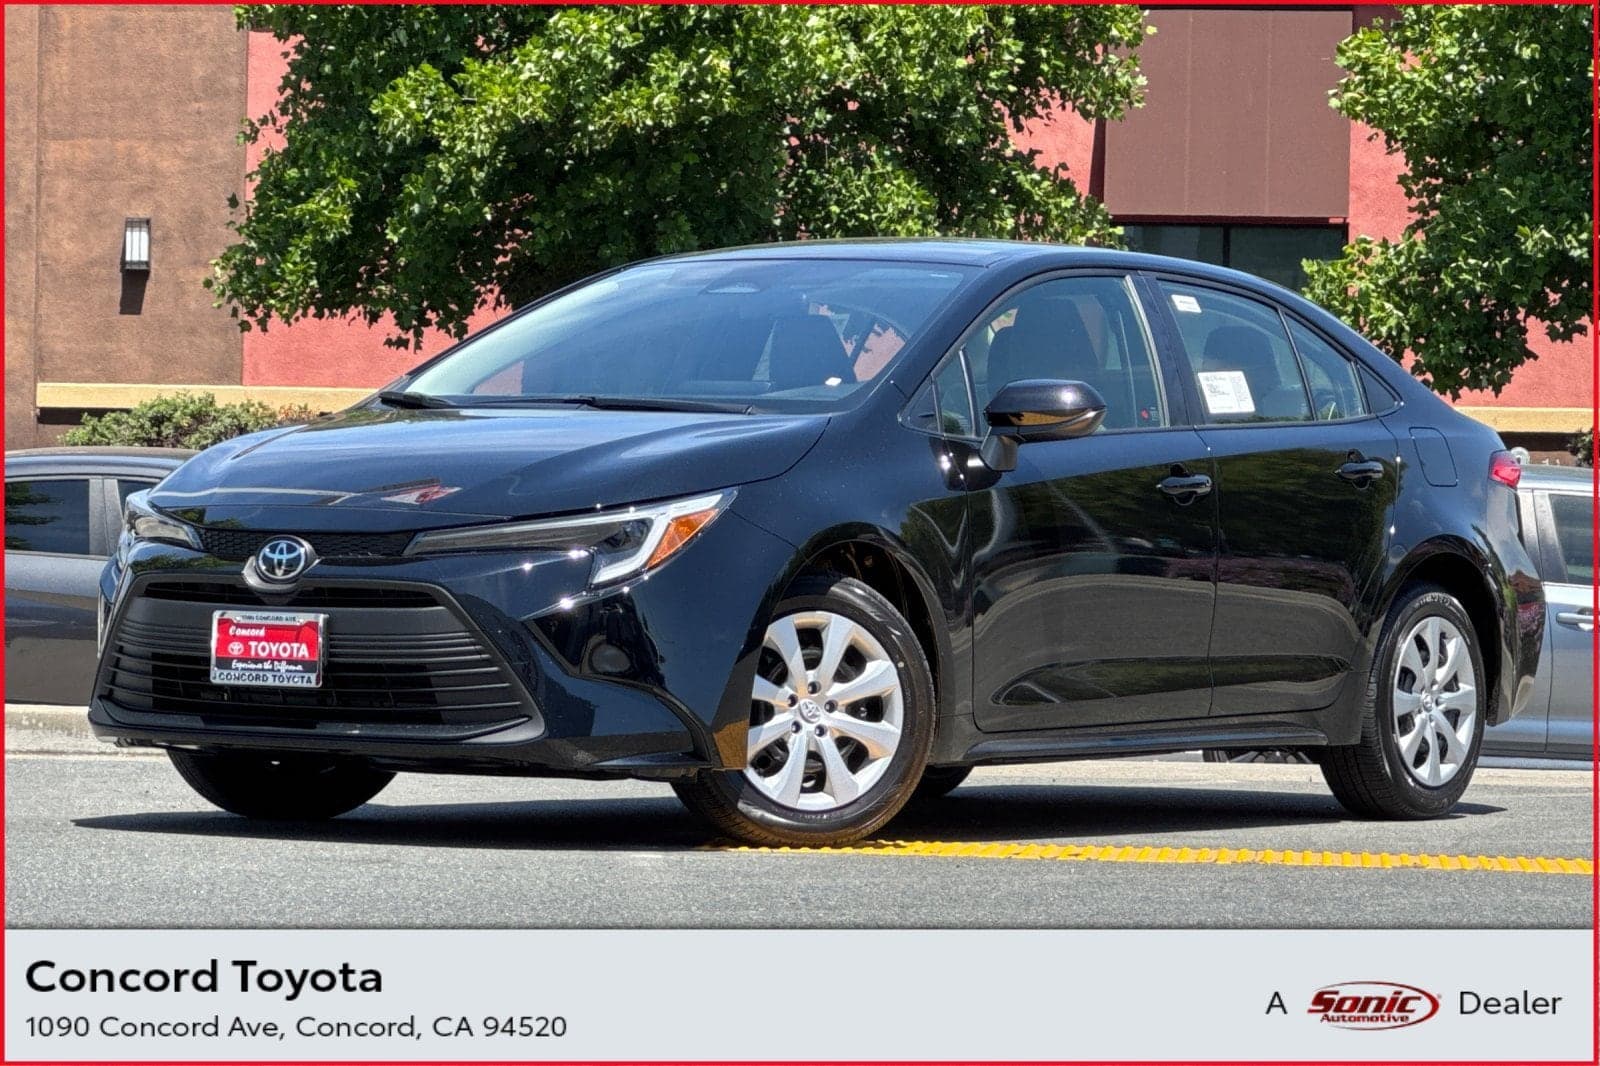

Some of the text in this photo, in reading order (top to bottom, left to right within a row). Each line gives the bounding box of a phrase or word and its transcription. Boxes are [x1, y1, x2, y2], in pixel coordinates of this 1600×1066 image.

[229, 626, 265, 636] Concord
[248, 641, 309, 657] TOYOTA
[263, 660, 272, 669] the
[218, 672, 312, 684] CONCORD TOYOTA
